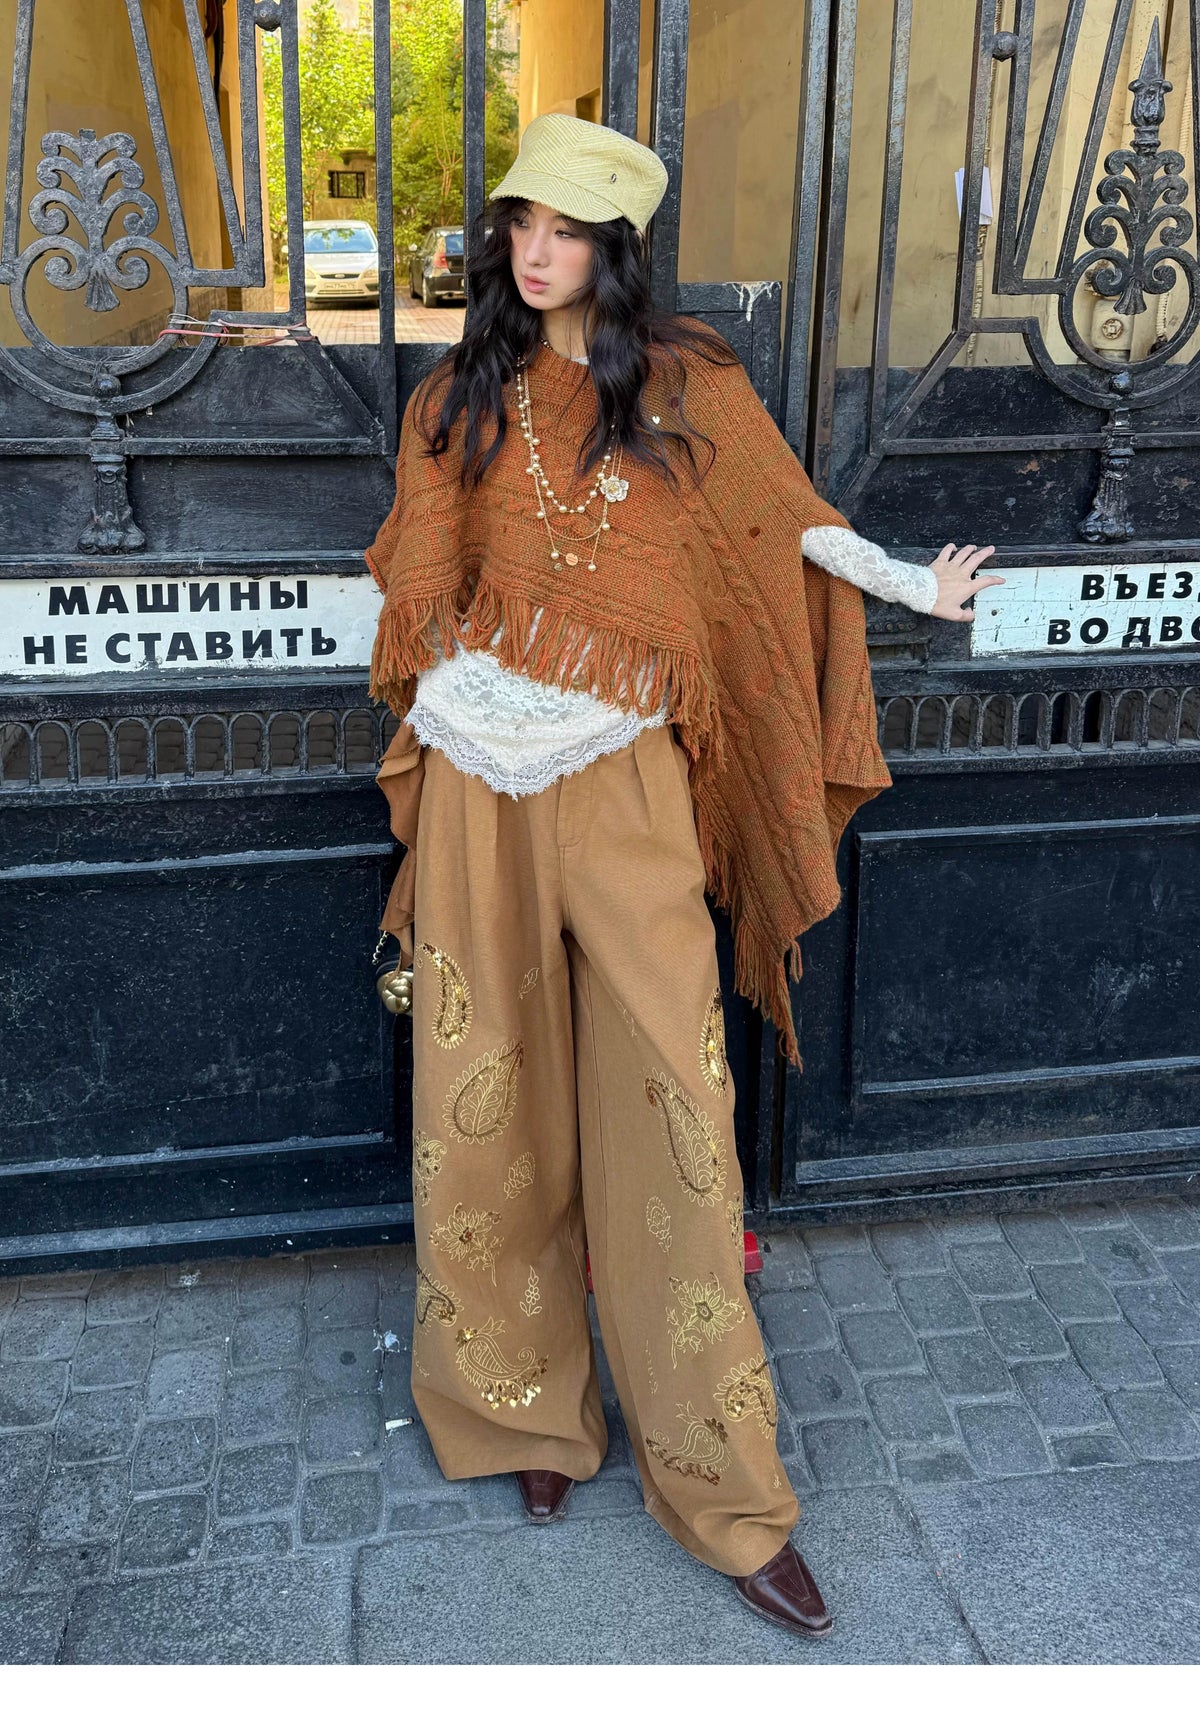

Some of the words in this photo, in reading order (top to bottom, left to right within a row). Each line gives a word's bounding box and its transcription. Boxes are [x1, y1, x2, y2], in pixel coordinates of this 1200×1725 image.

[48, 580, 309, 616] МАШИНЫ
[1080, 571, 1200, 602] ВЪЕЗ
[23, 634, 88, 665] НЕ
[105, 627, 338, 665] СТАВИТЬ
[1047, 617, 1109, 645] ВО
